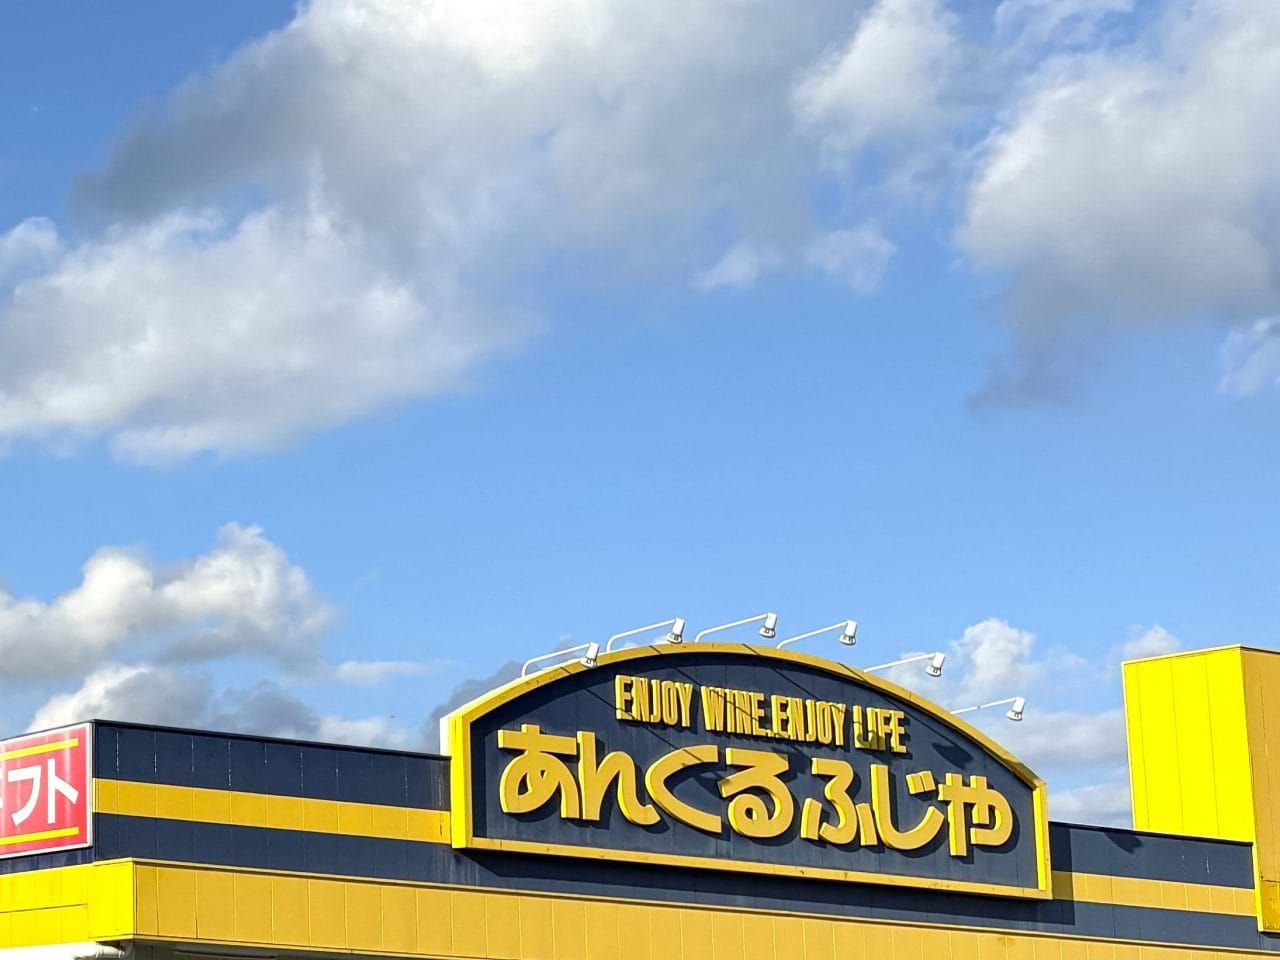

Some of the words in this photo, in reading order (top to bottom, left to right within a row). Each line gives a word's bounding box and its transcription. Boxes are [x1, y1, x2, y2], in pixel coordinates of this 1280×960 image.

[615, 674, 693, 728] ENJOY
[853, 705, 907, 753] LIFE
[497, 724, 1014, 858] あんくるふじや
